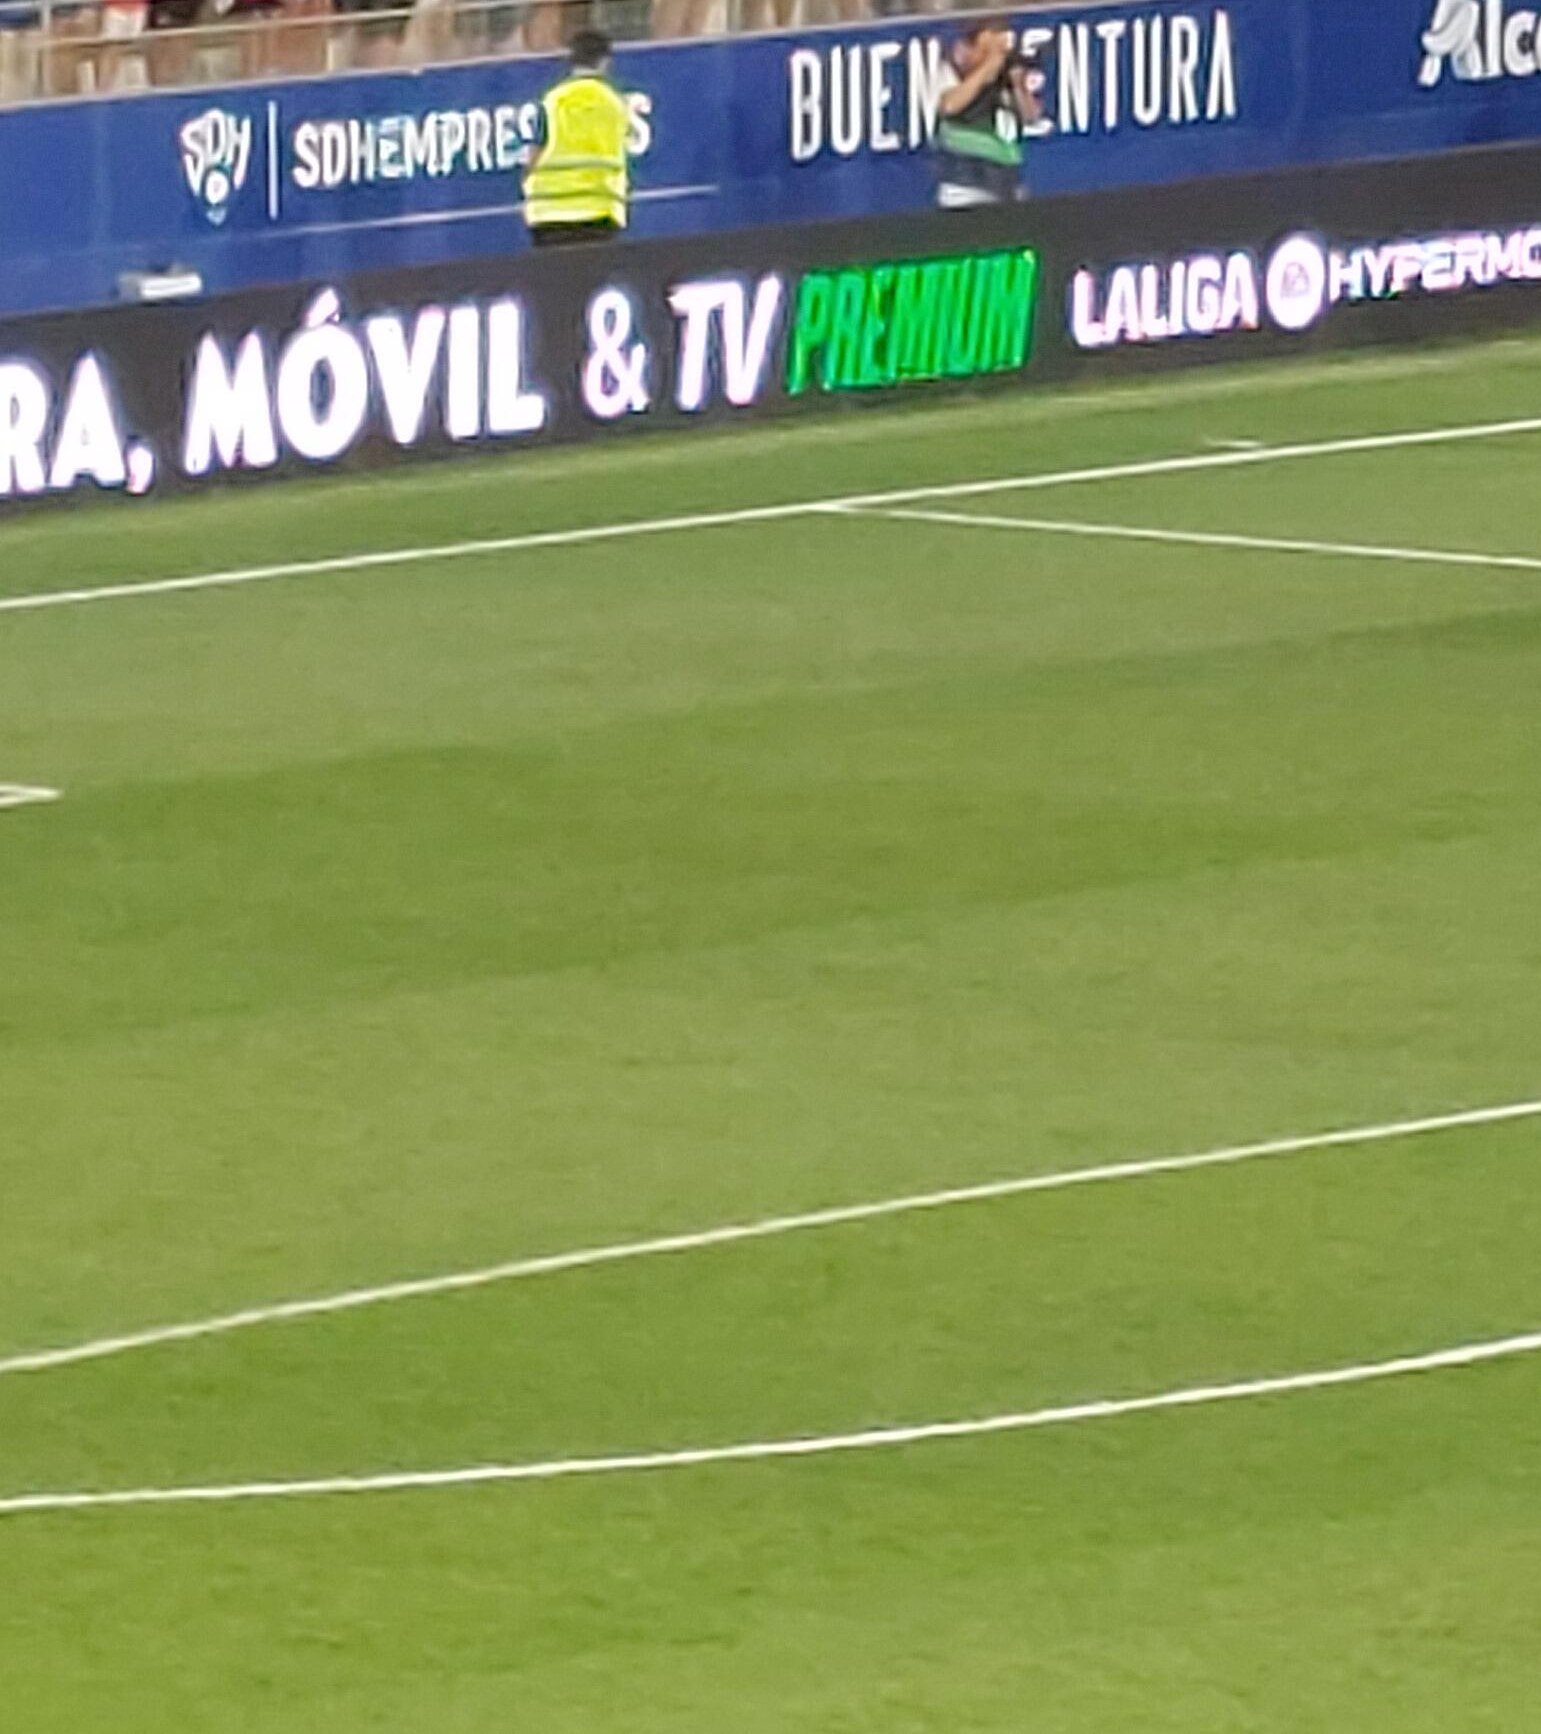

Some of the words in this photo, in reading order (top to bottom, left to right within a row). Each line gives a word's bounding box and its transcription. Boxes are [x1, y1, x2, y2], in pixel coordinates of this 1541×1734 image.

[184, 288, 546, 474] MÓVIL
[584, 288, 651, 419] &
[669, 273, 783, 413] TV
[787, 248, 1038, 396] PREMIUM
[1071, 252, 1260, 348] LALIGA
